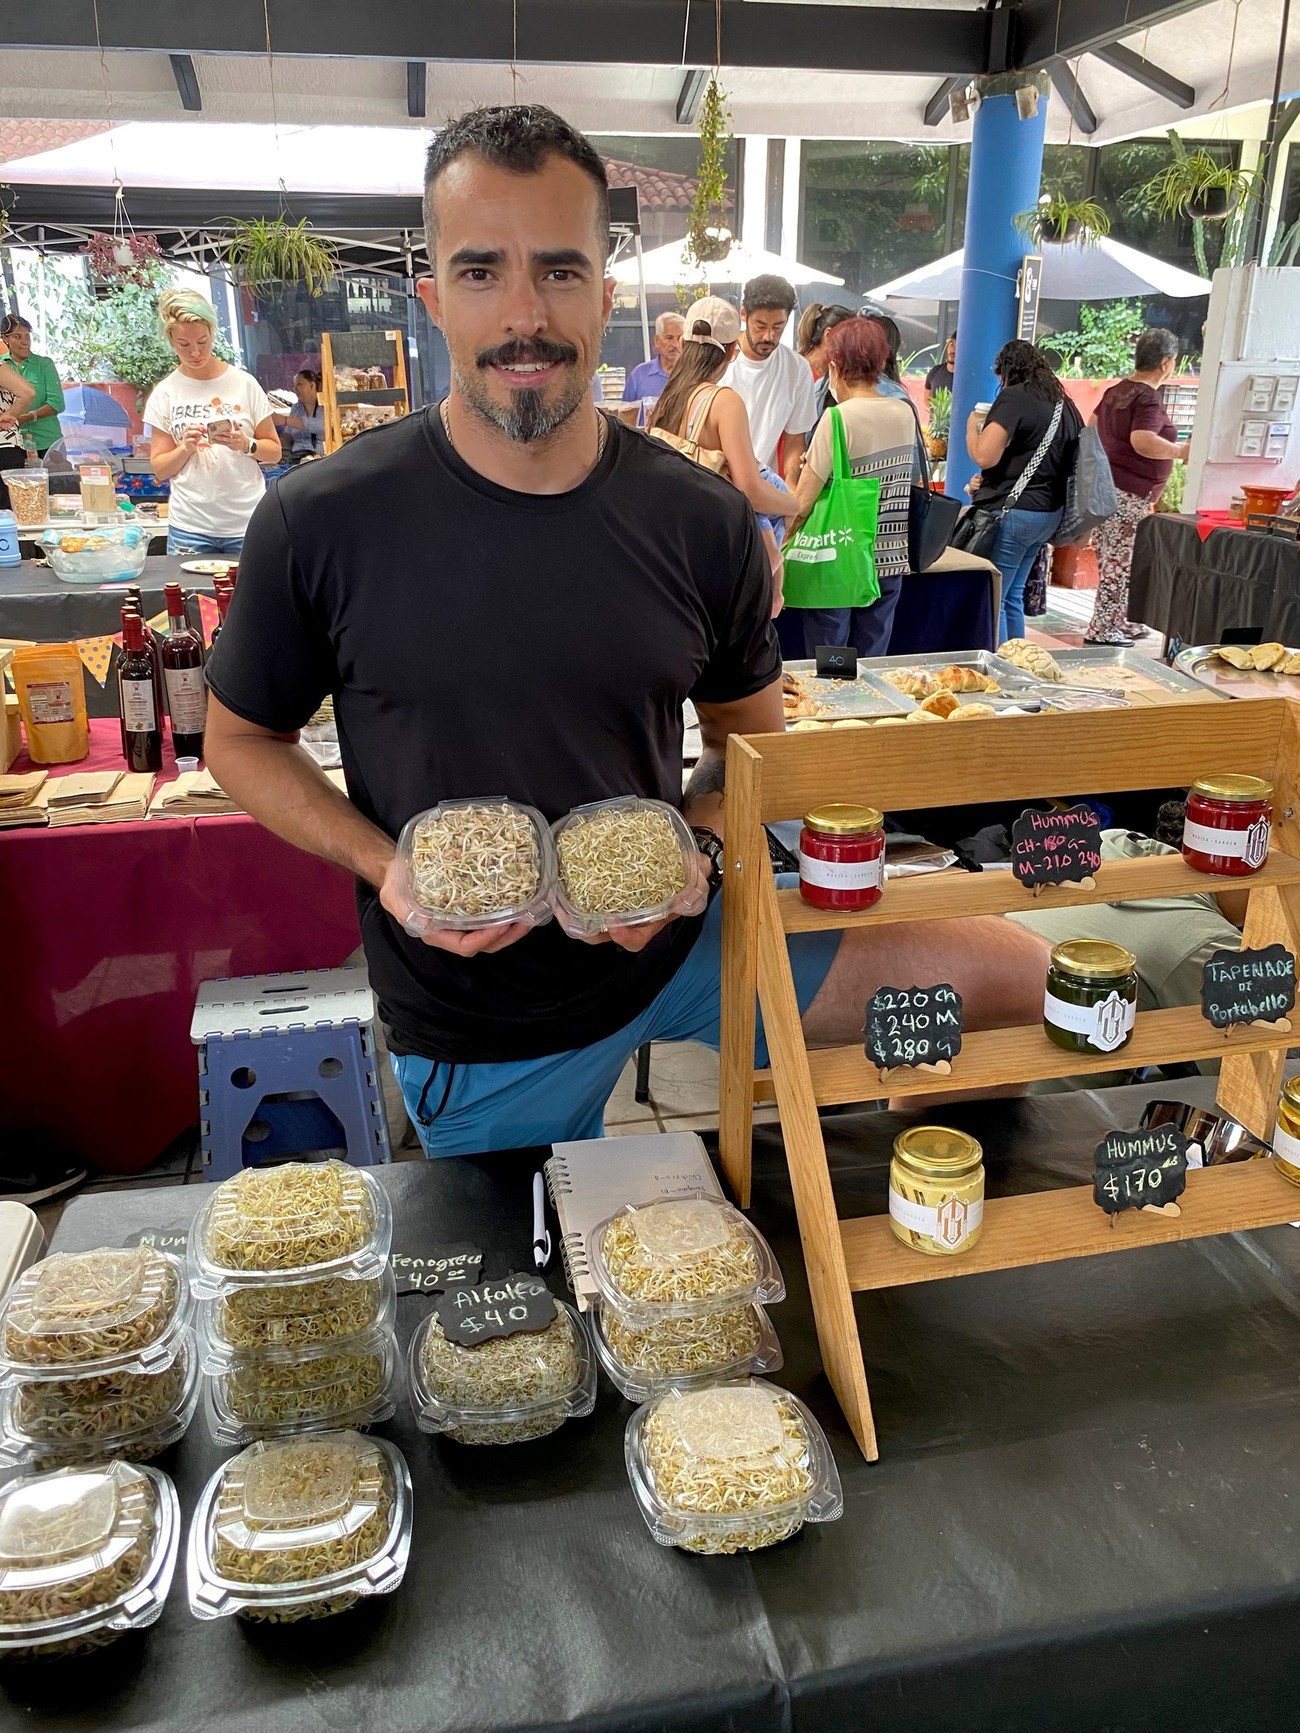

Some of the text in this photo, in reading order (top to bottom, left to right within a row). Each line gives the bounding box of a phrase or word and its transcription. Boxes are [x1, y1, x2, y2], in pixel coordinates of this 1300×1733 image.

[829, 655, 845, 667] 40
[1205, 959, 1294, 982] TAPENADE
[935, 1009, 959, 1026] M
[1209, 993, 1288, 1021] Portabello
[1106, 1133, 1177, 1159] HUMMUS
[1103, 1168, 1162, 1202] $170
[139, 1234, 188, 1248] Mun
